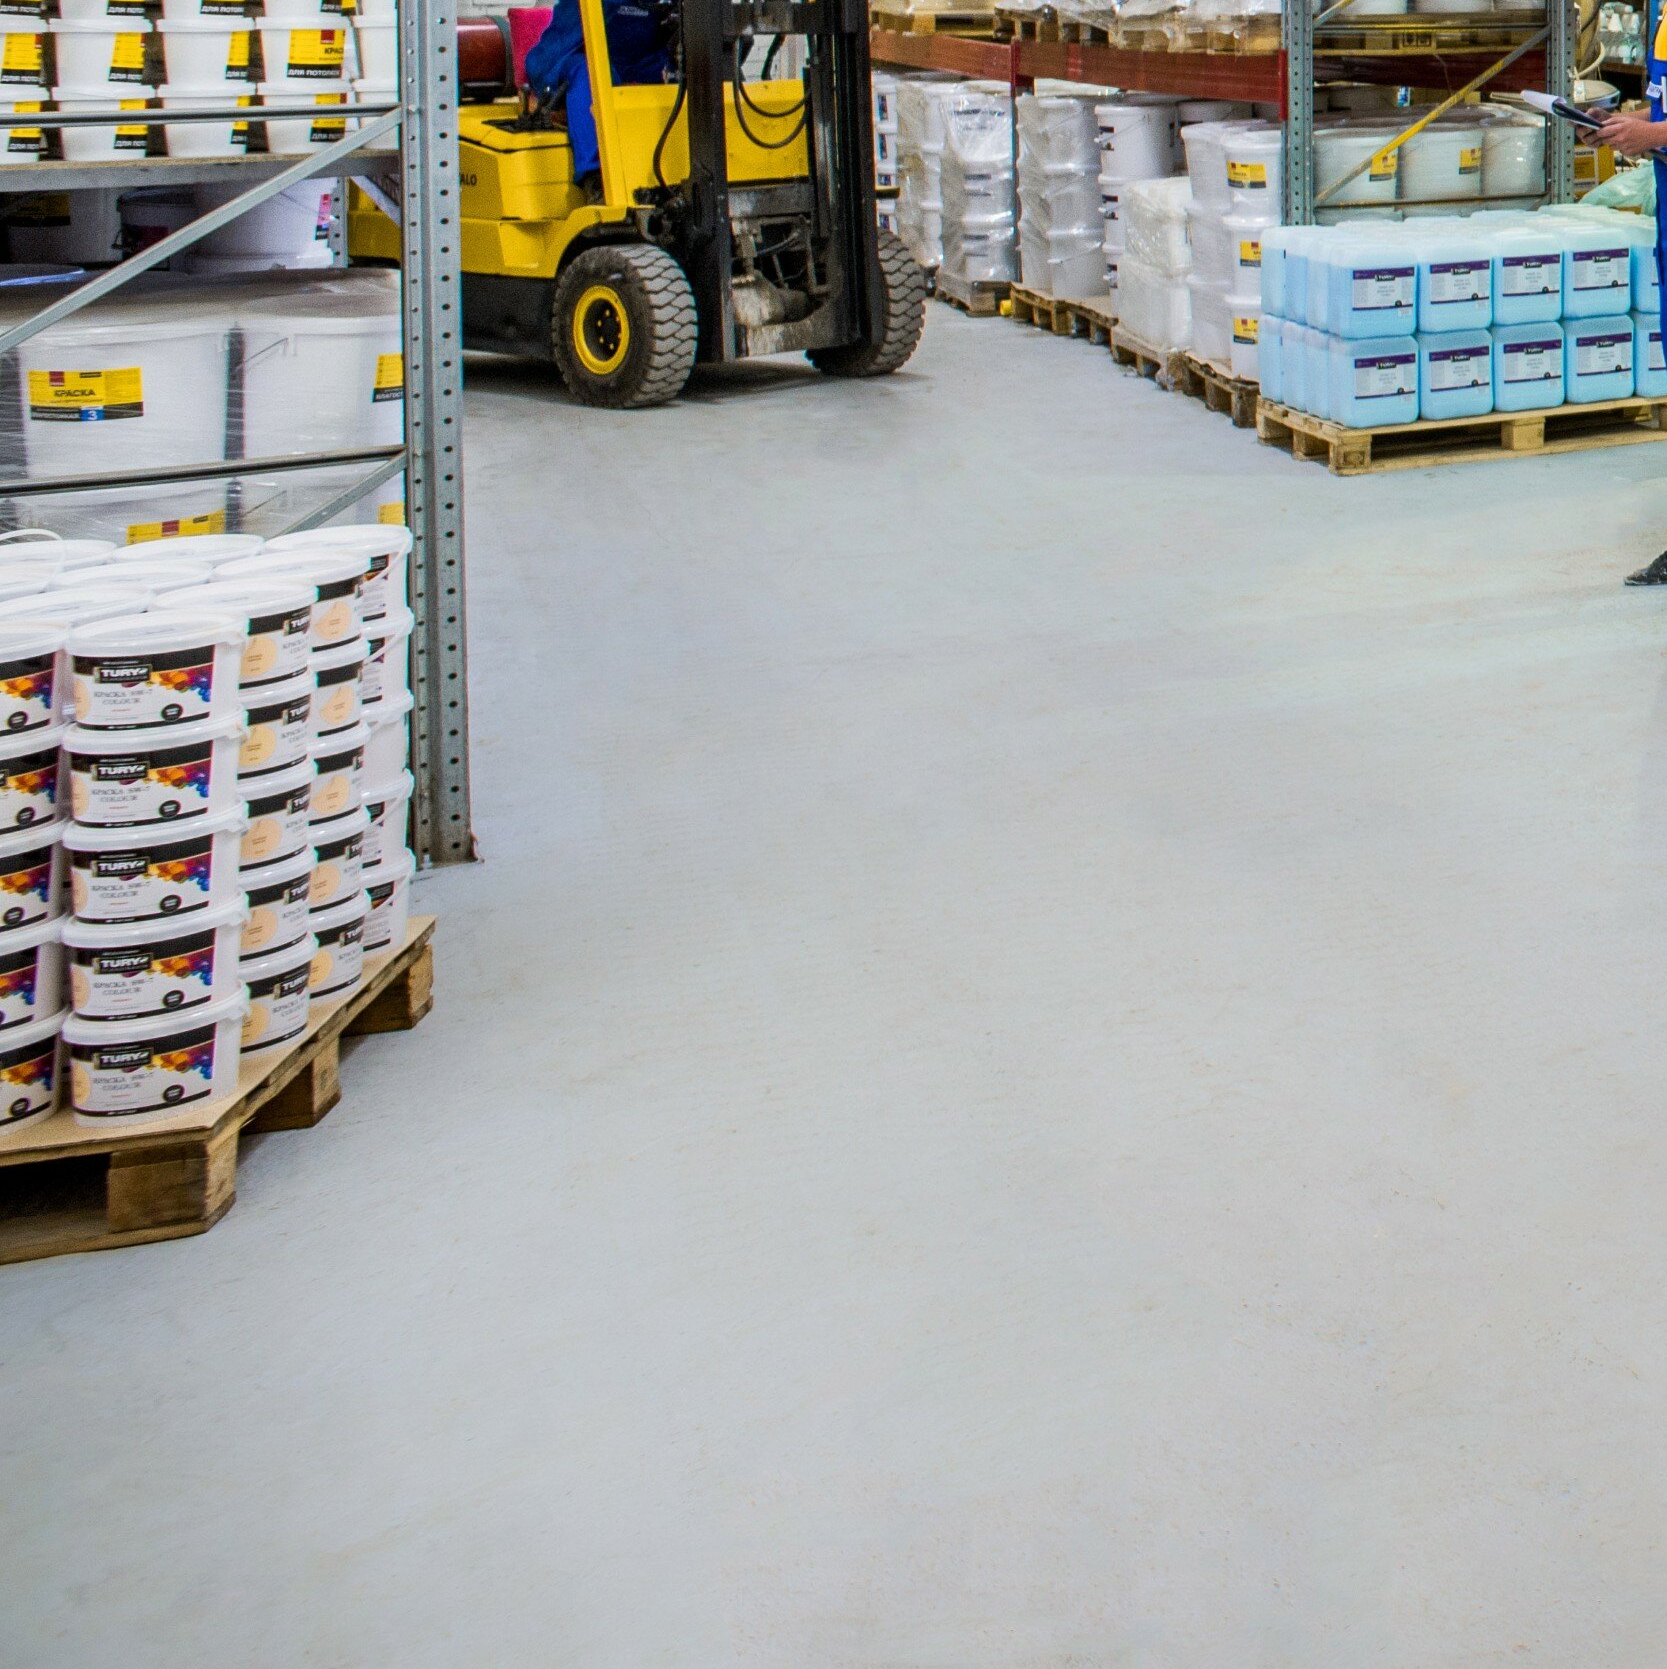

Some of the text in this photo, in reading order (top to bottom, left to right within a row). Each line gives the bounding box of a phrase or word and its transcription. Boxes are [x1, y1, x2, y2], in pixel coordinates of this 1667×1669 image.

[88, 410, 97, 420] 3
[101, 668, 139, 677] TURY
[99, 765, 137, 774] TURY
[99, 862, 135, 870] TURY
[101, 958, 138, 967] TURY
[101, 1053, 139, 1063] TURY
